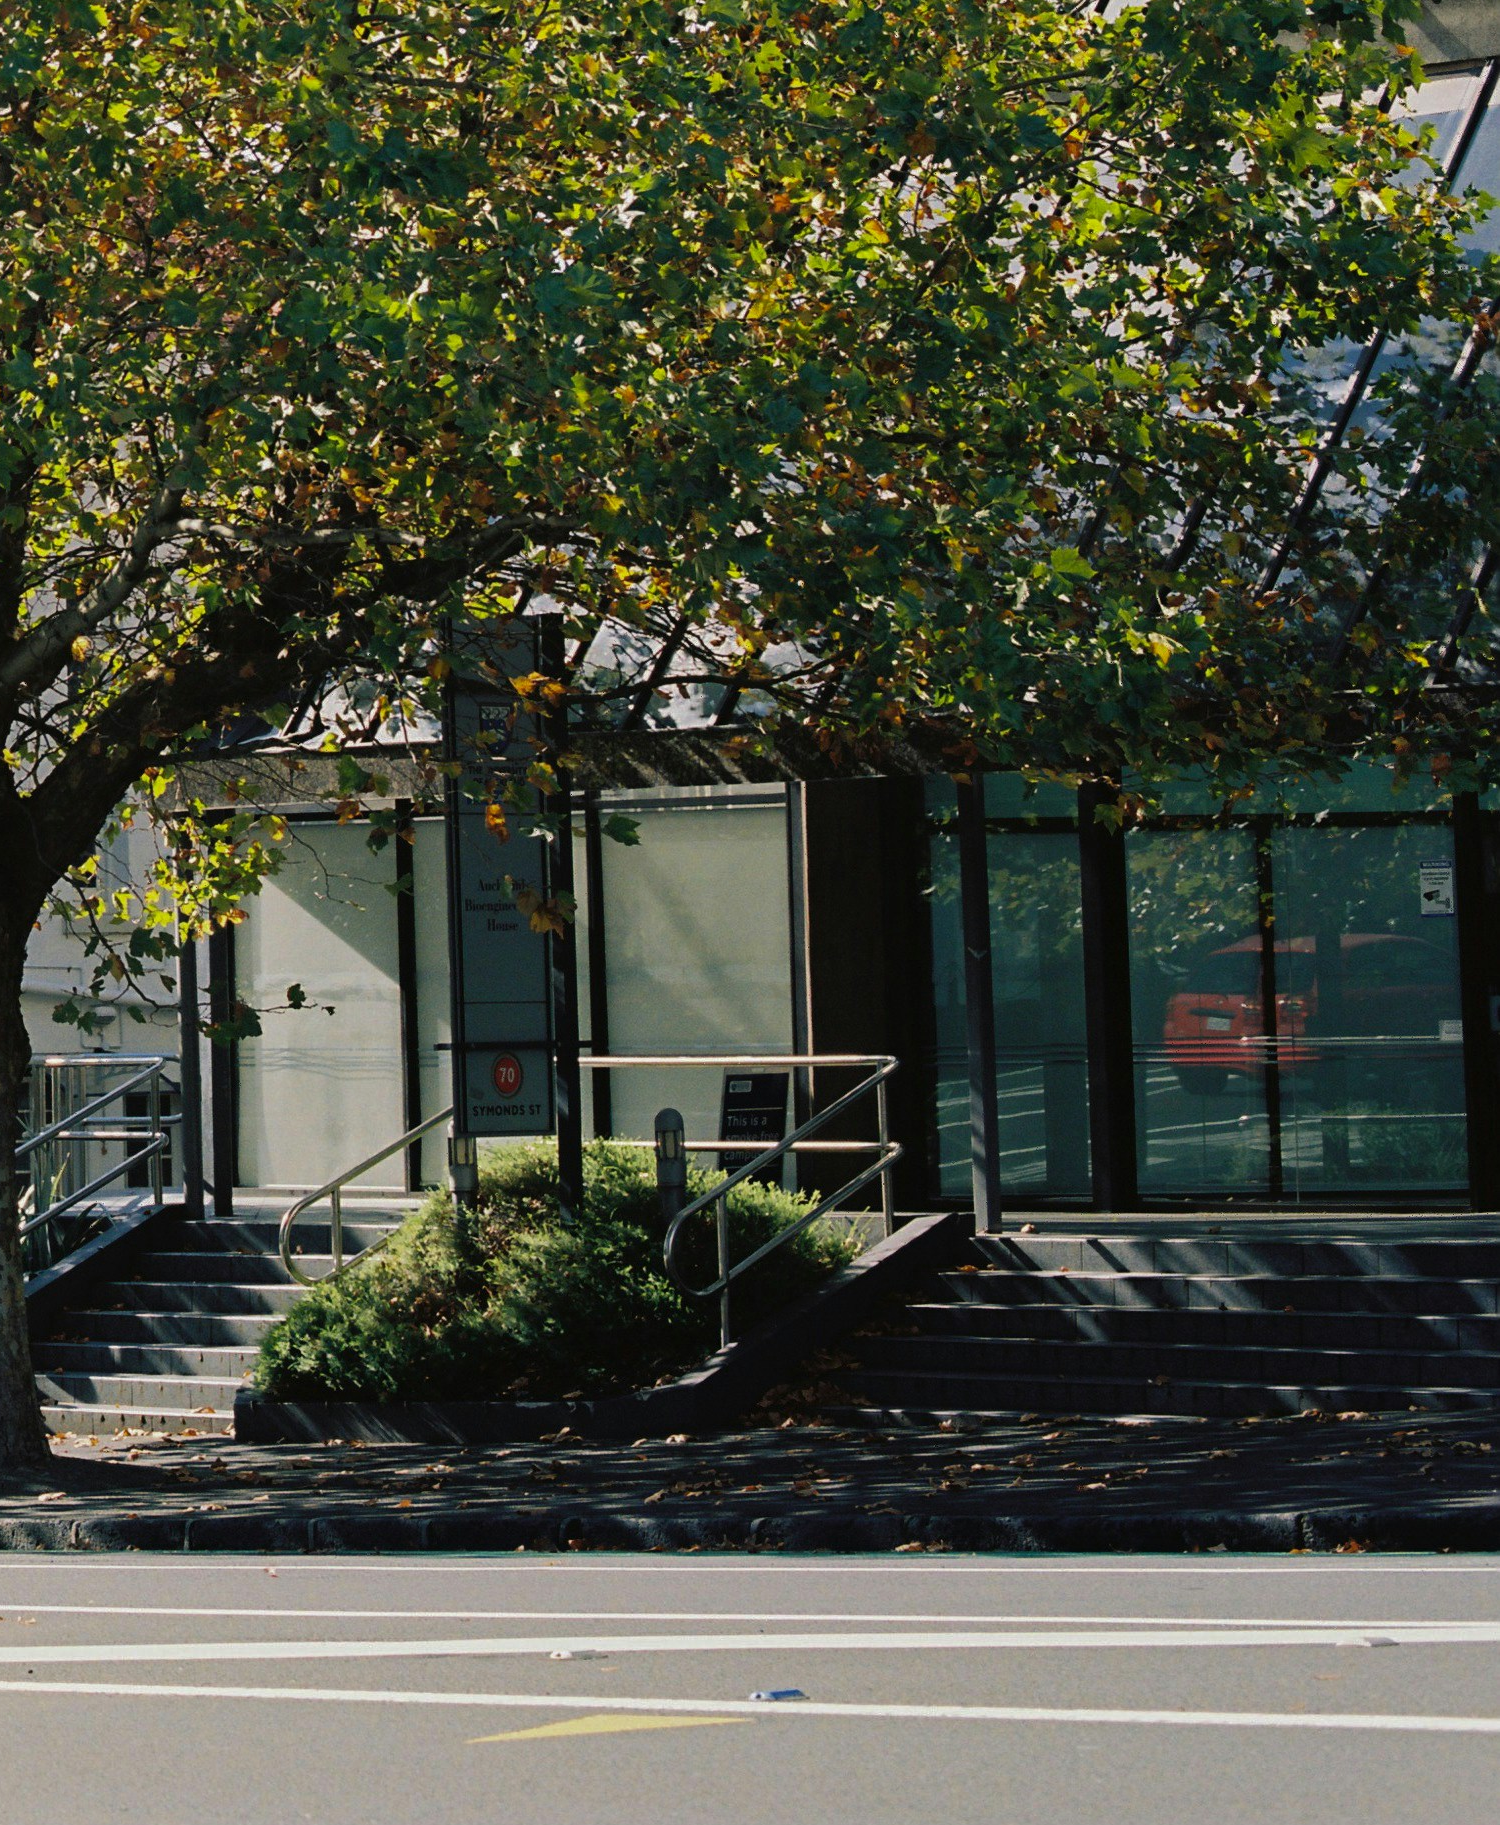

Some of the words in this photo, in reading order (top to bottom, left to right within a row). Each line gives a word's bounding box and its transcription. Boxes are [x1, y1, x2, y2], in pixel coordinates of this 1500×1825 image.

[487, 918, 519, 931] House
[499, 1067, 515, 1083] 70
[472, 1105, 526, 1117] SYMONDS
[528, 1104, 541, 1115] ST
[726, 1115, 747, 1127] This
[750, 1115, 760, 1126] is
[761, 1117, 767, 1126] a
[724, 1150, 762, 1162] campu
